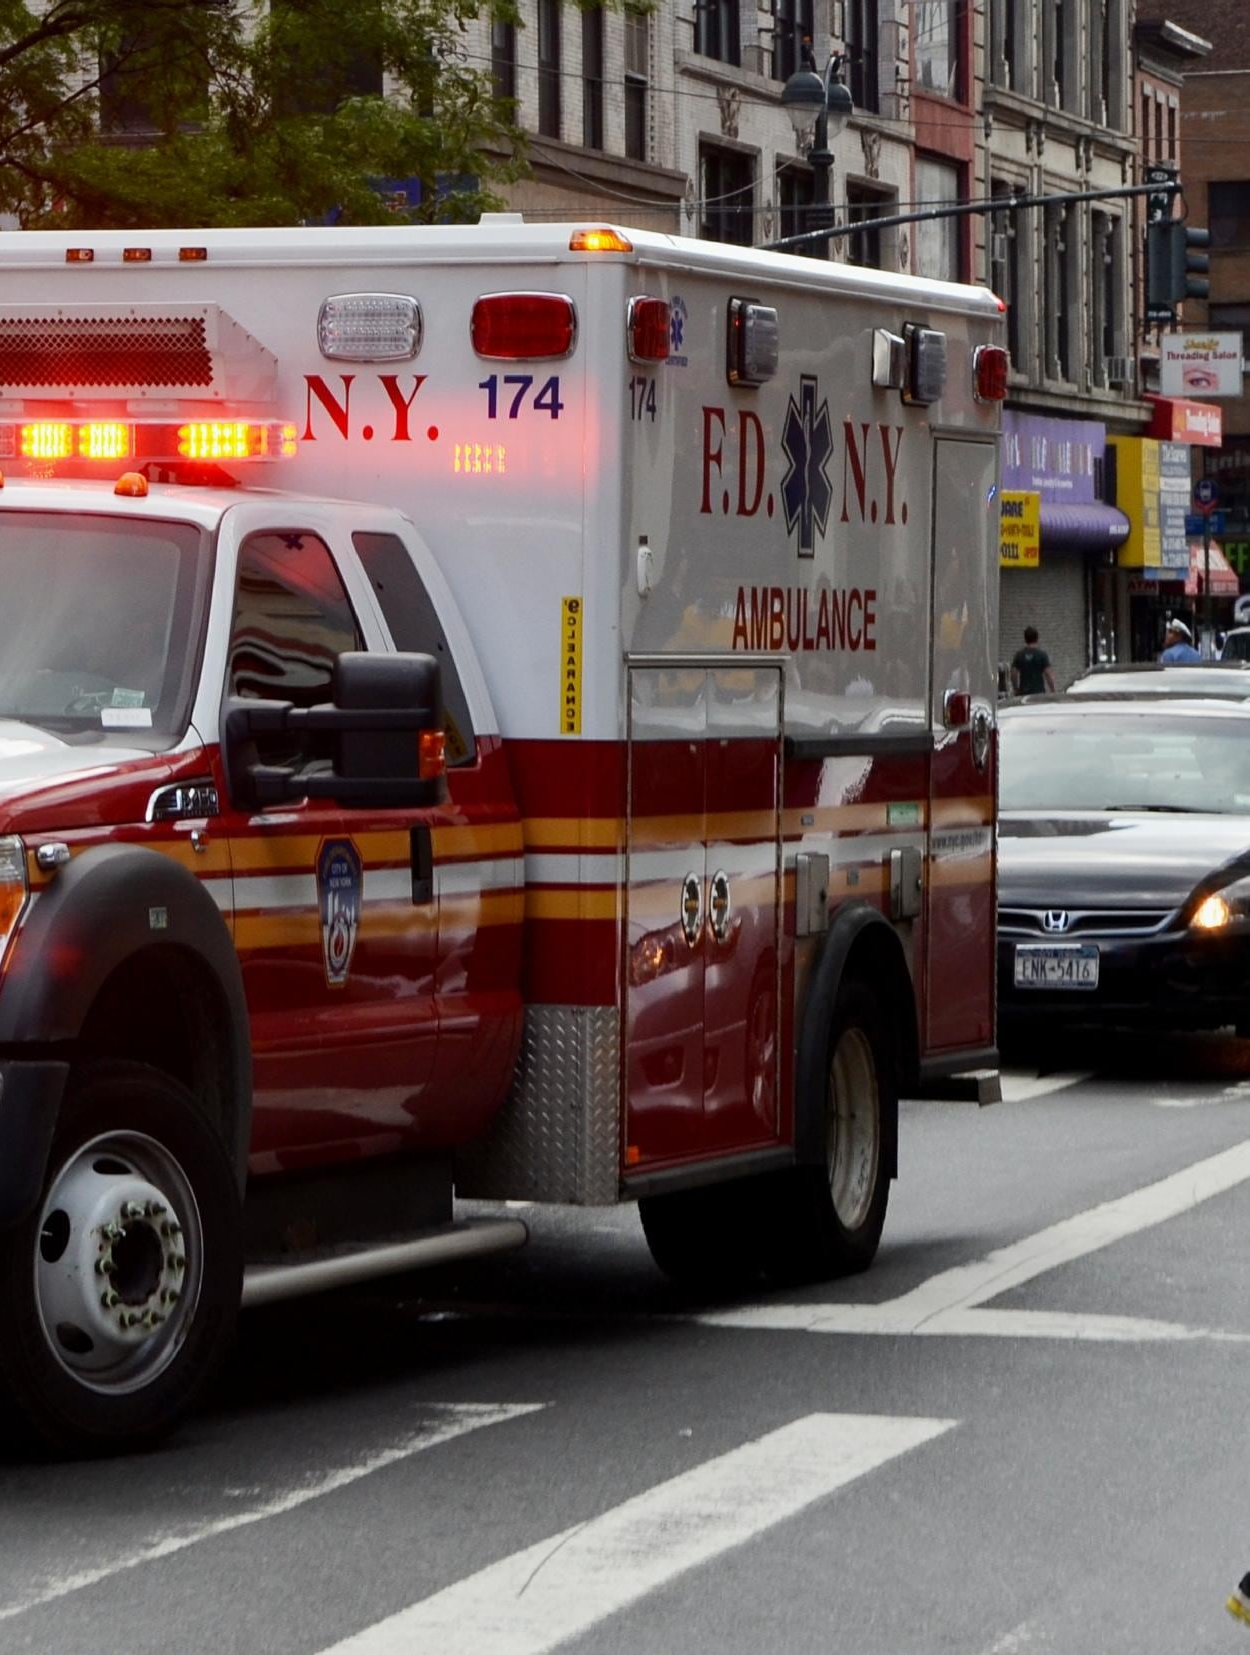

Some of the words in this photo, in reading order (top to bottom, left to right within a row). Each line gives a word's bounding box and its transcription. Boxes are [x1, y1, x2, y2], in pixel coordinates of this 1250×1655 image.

[1167, 351, 1210, 361] Threading
[1212, 351, 1238, 360] Salon
[301, 374, 439, 440] N.Y.
[479, 374, 564, 419] 174
[629, 376, 656, 422] 174
[700, 406, 774, 518] F.D.
[840, 421, 908, 525] N.Y.
[732, 586, 877, 652] AMBULANCE
